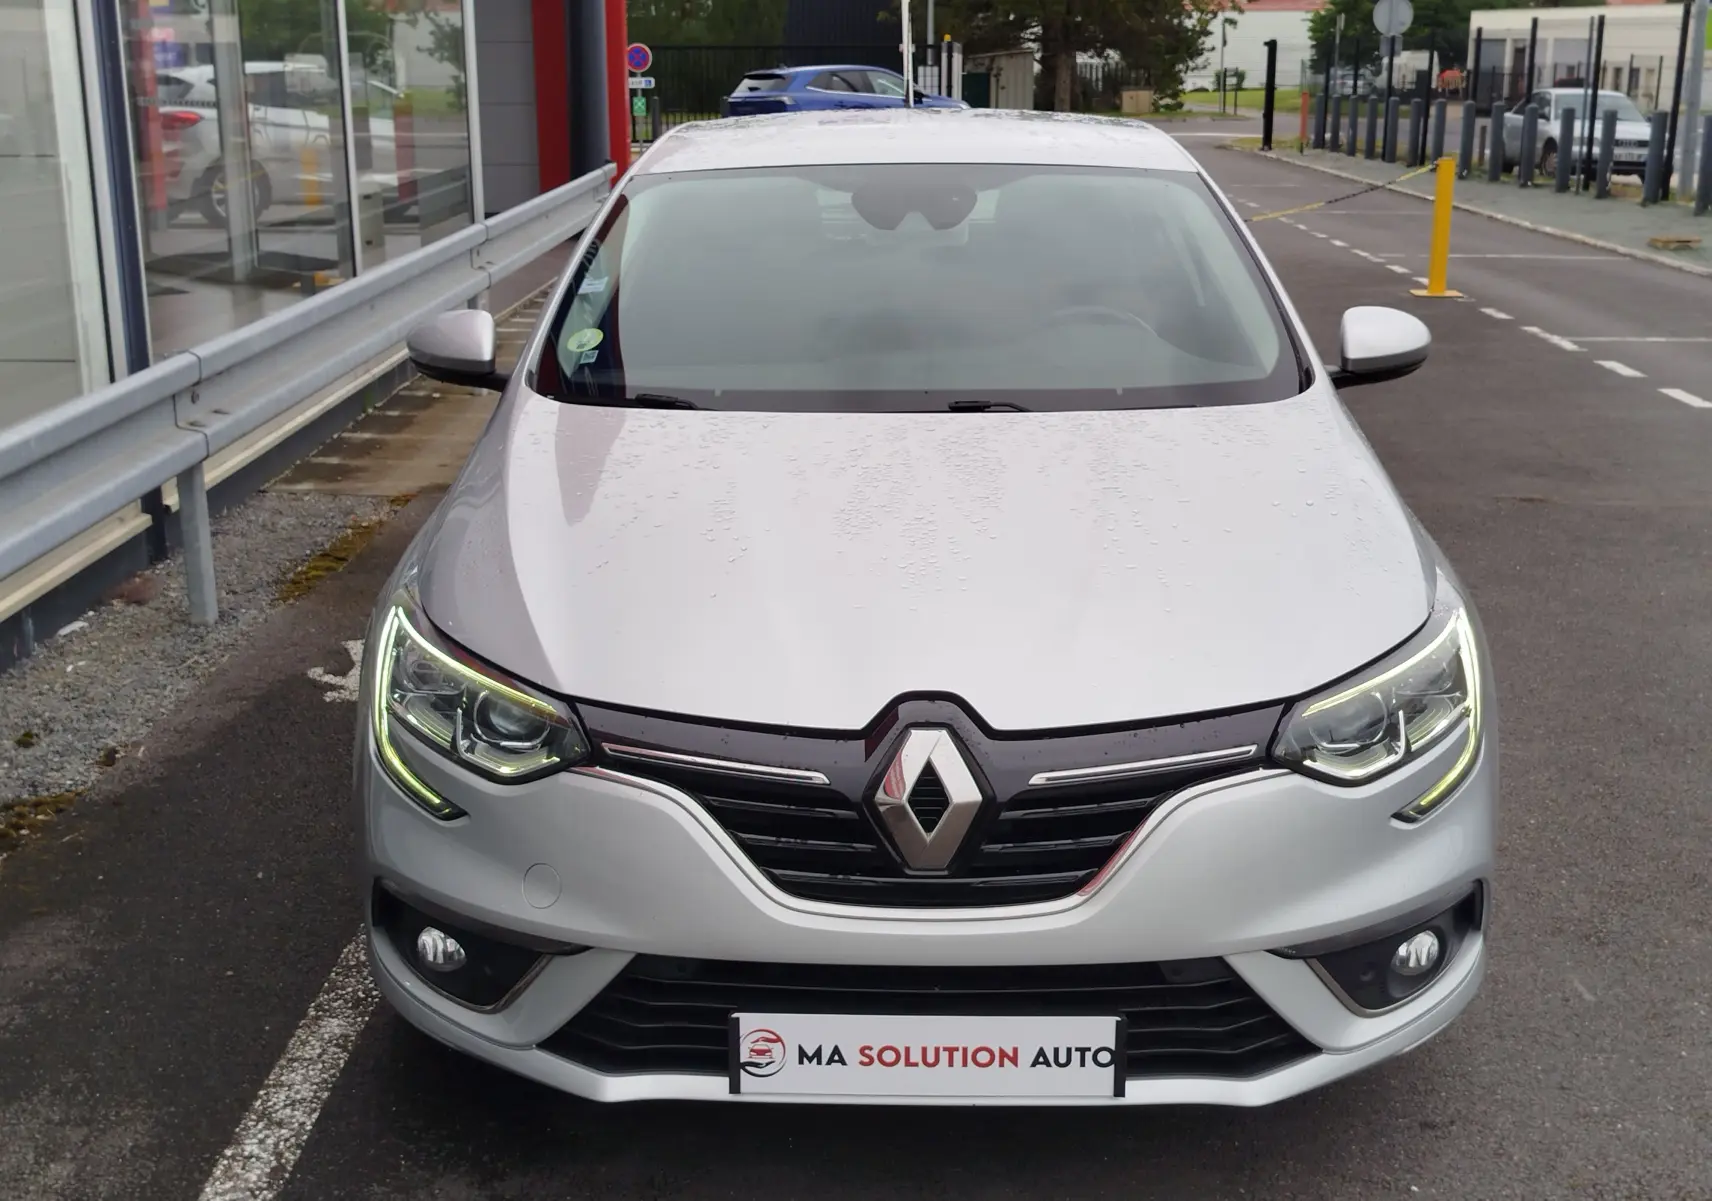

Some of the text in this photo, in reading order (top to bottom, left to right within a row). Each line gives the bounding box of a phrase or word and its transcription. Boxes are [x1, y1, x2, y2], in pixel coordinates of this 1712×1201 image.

[797, 1044, 1116, 1068] MA SOLUTION AUTO
